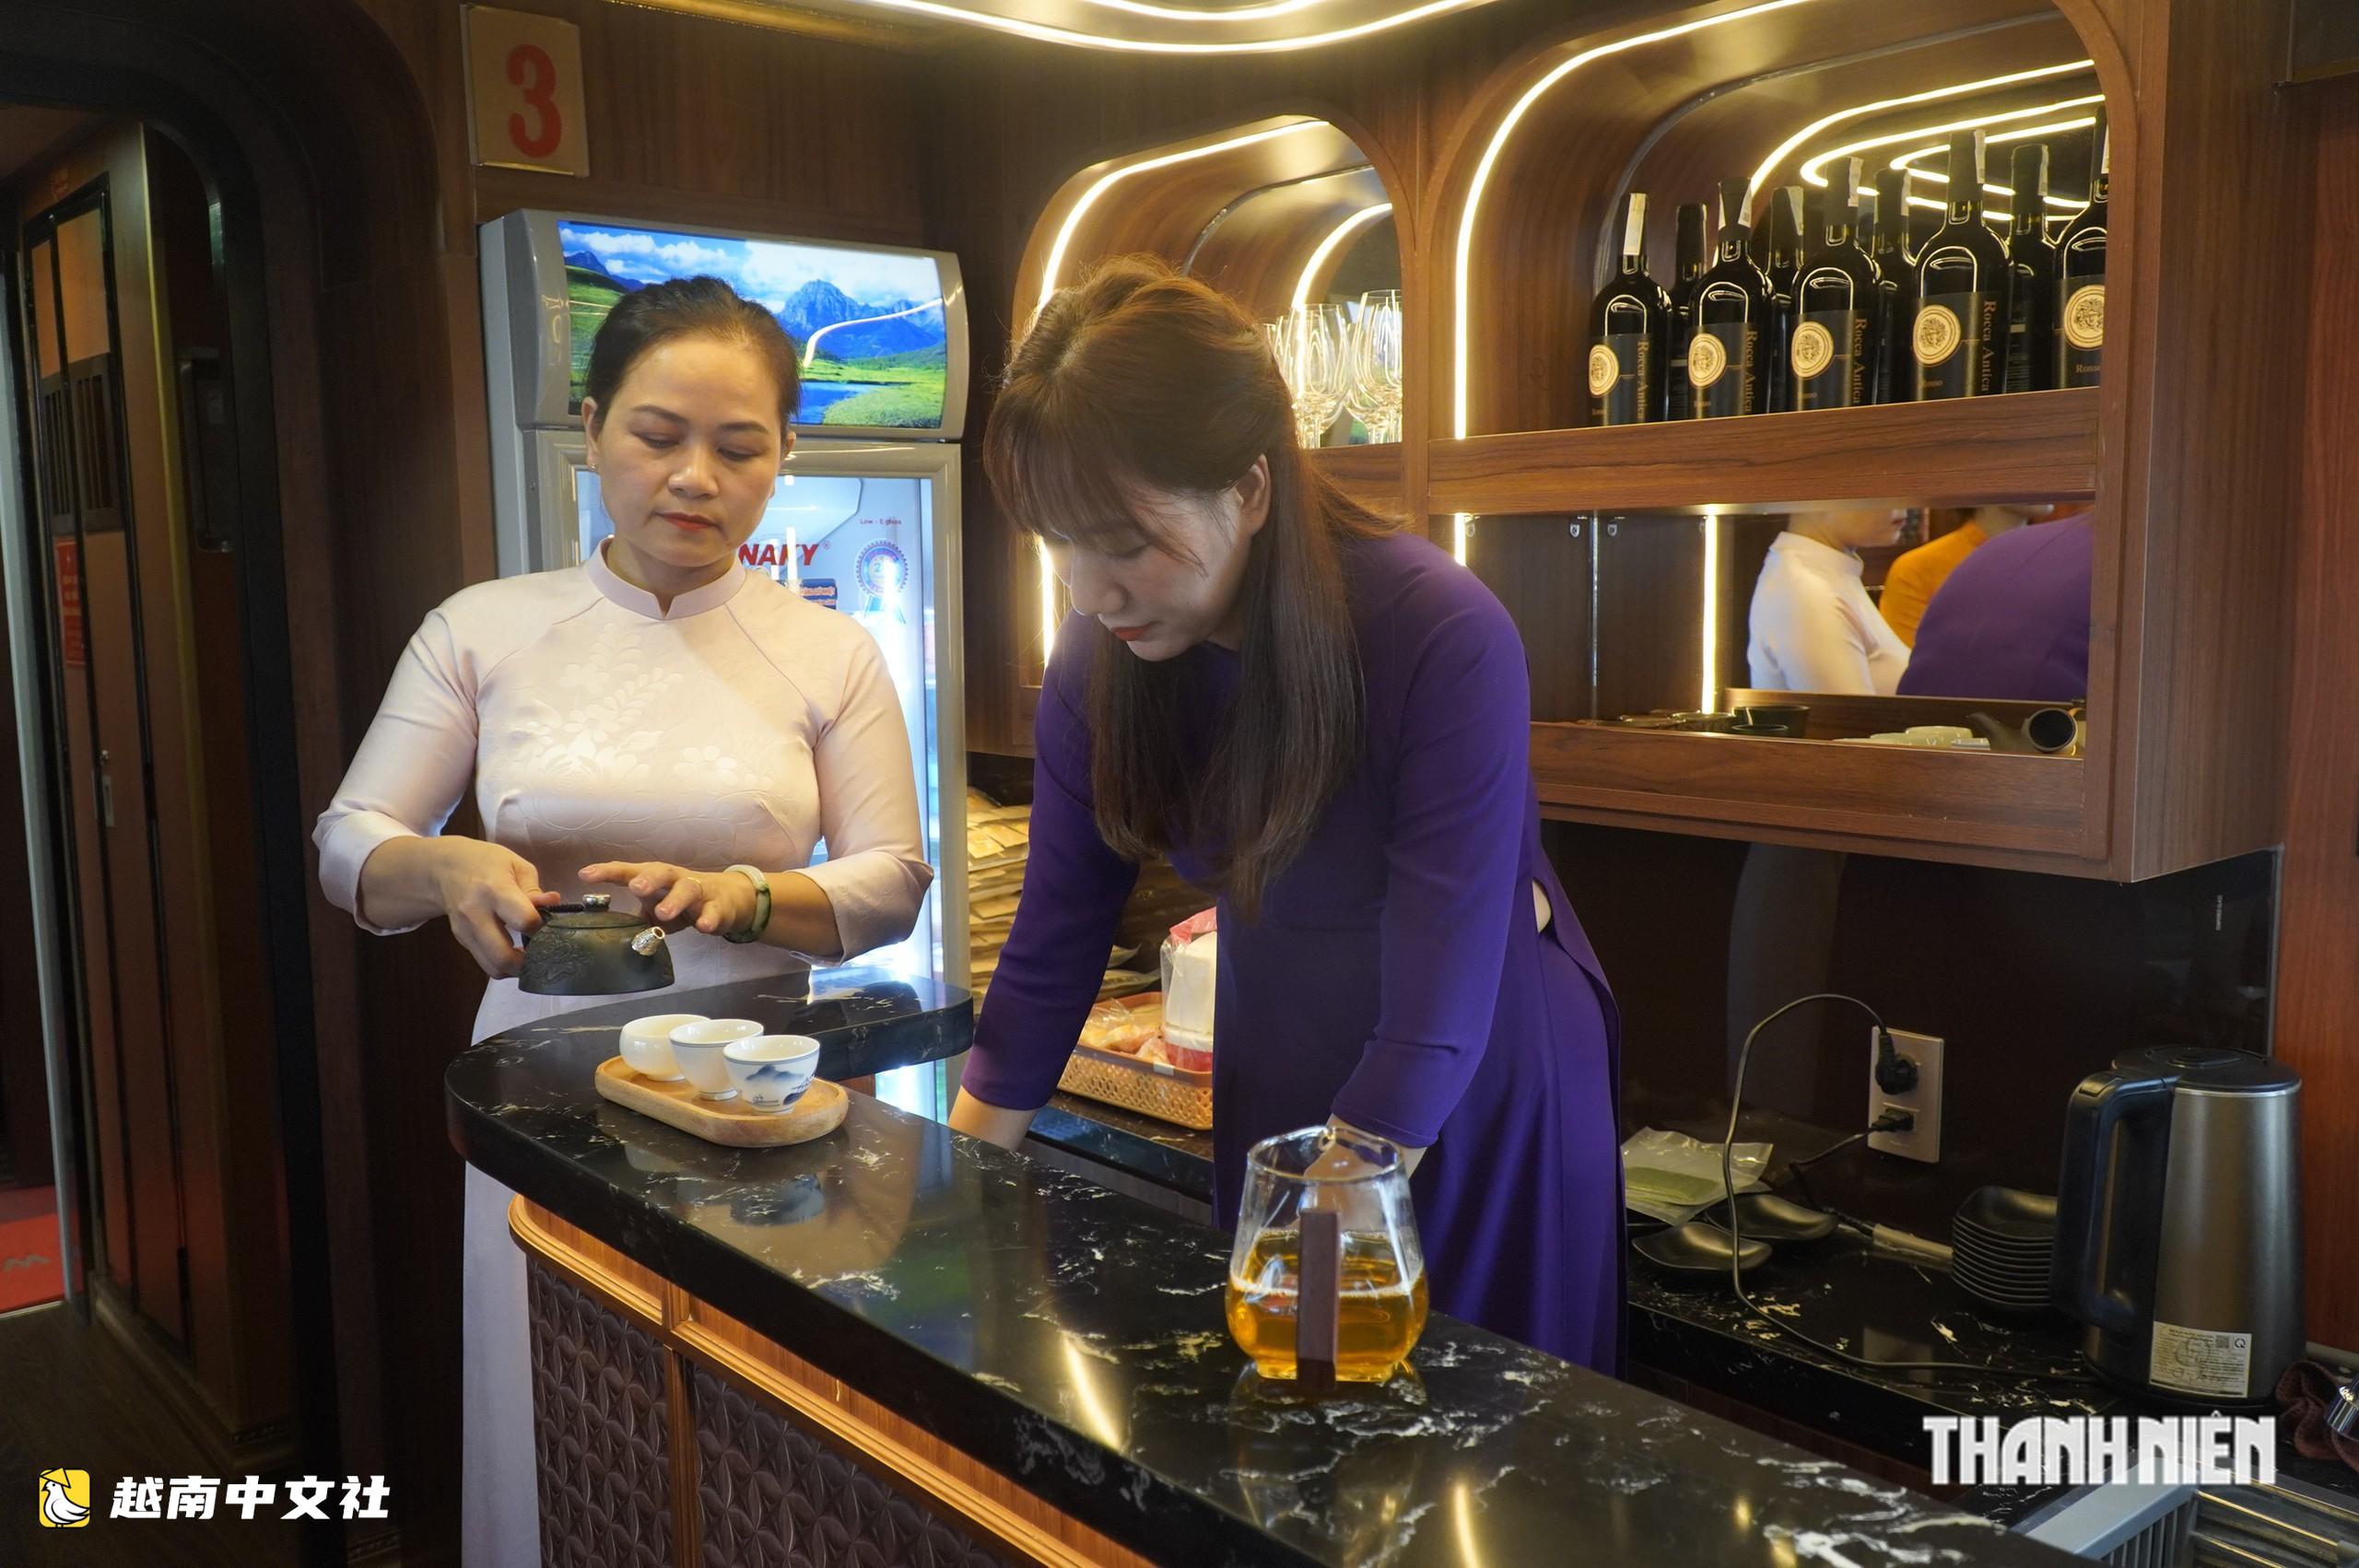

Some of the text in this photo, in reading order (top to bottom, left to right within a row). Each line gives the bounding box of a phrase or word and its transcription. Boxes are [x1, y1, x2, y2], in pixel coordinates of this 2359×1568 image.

[508, 44, 562, 158] 3
[1746, 331, 1758, 367] Rocca
[1854, 318, 1868, 357] Rocca
[1981, 300, 1997, 392] Rocca Antica
[1637, 341, 1649, 376] Rocca
